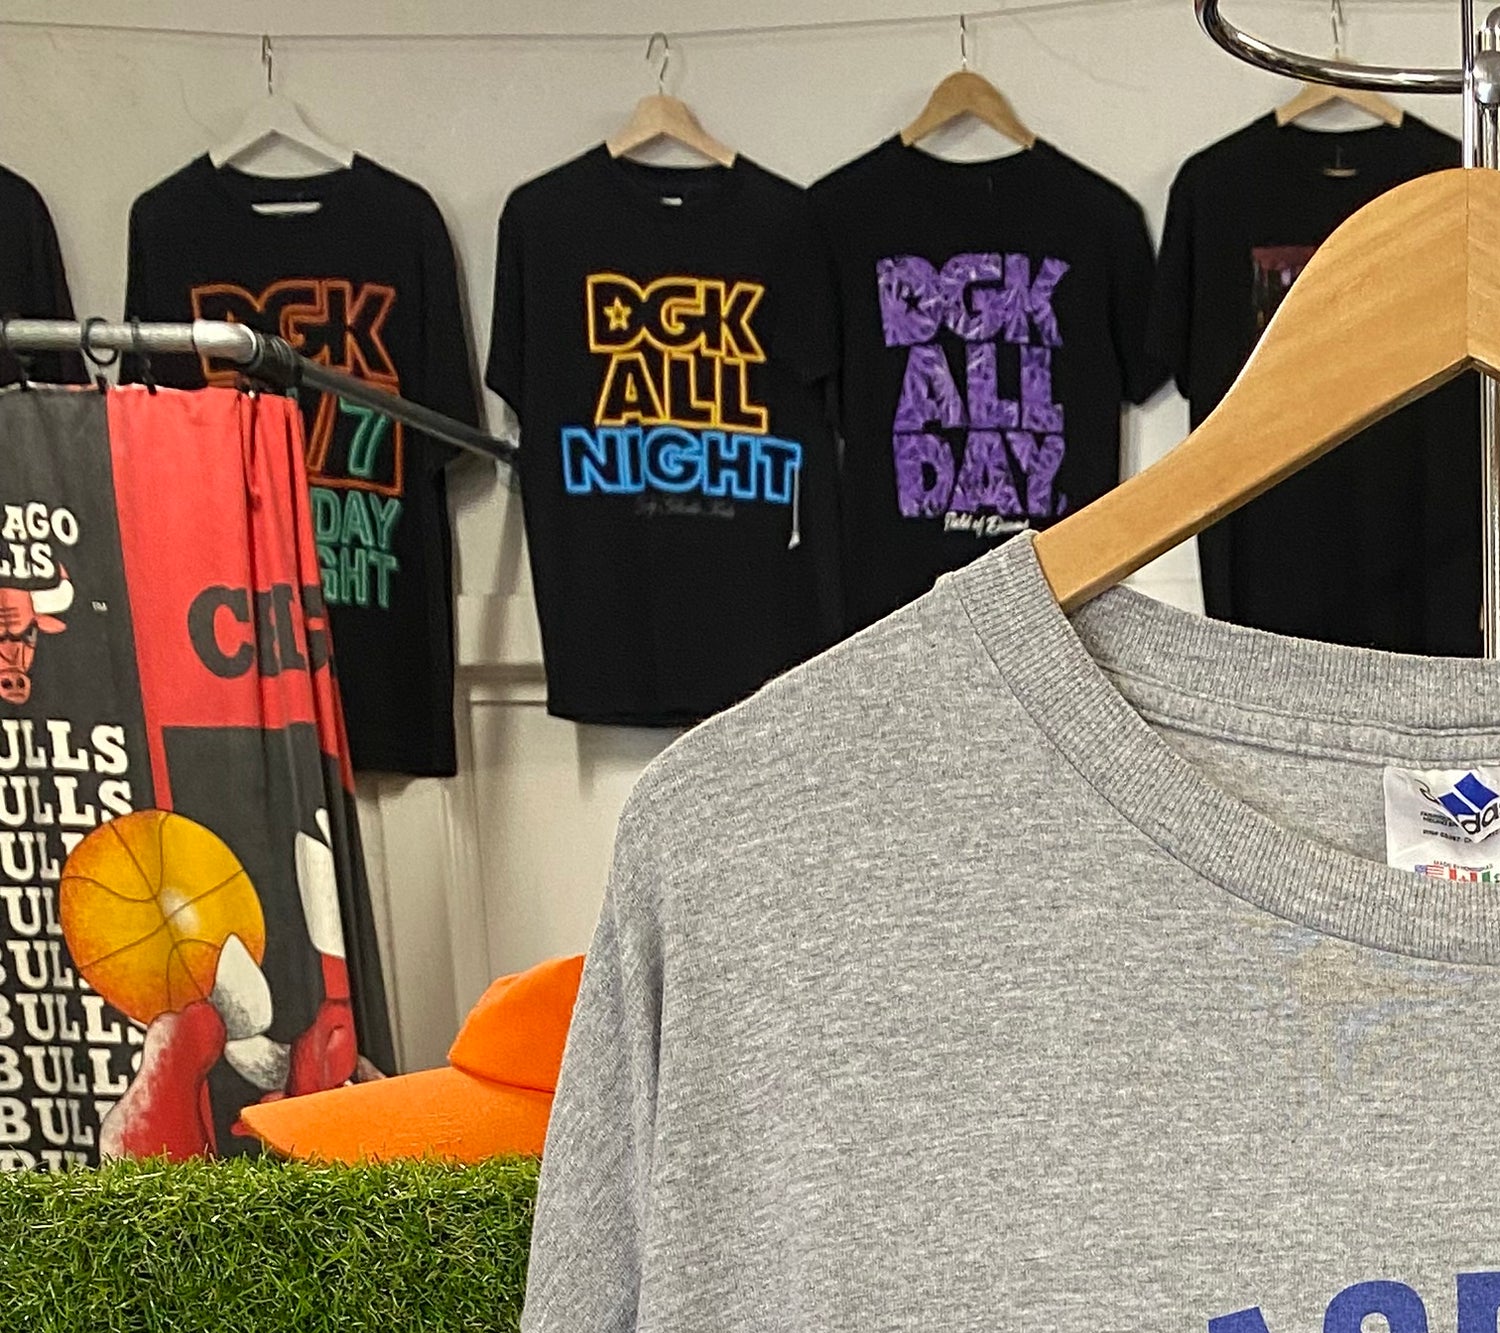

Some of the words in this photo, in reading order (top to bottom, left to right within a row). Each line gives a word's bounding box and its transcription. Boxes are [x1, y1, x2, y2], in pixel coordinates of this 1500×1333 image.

[586, 273, 767, 364] DGK
[876, 252, 1071, 347] DGK
[594, 350, 768, 435] ALL
[893, 342, 1065, 434] ALL
[561, 427, 802, 504] NIGHT
[893, 430, 1066, 518] DAY
[310, 487, 401, 550] DAY
[317, 545, 398, 608] GHT
[0, 719, 128, 775] ULLS
[0, 775, 133, 827] ULLS
